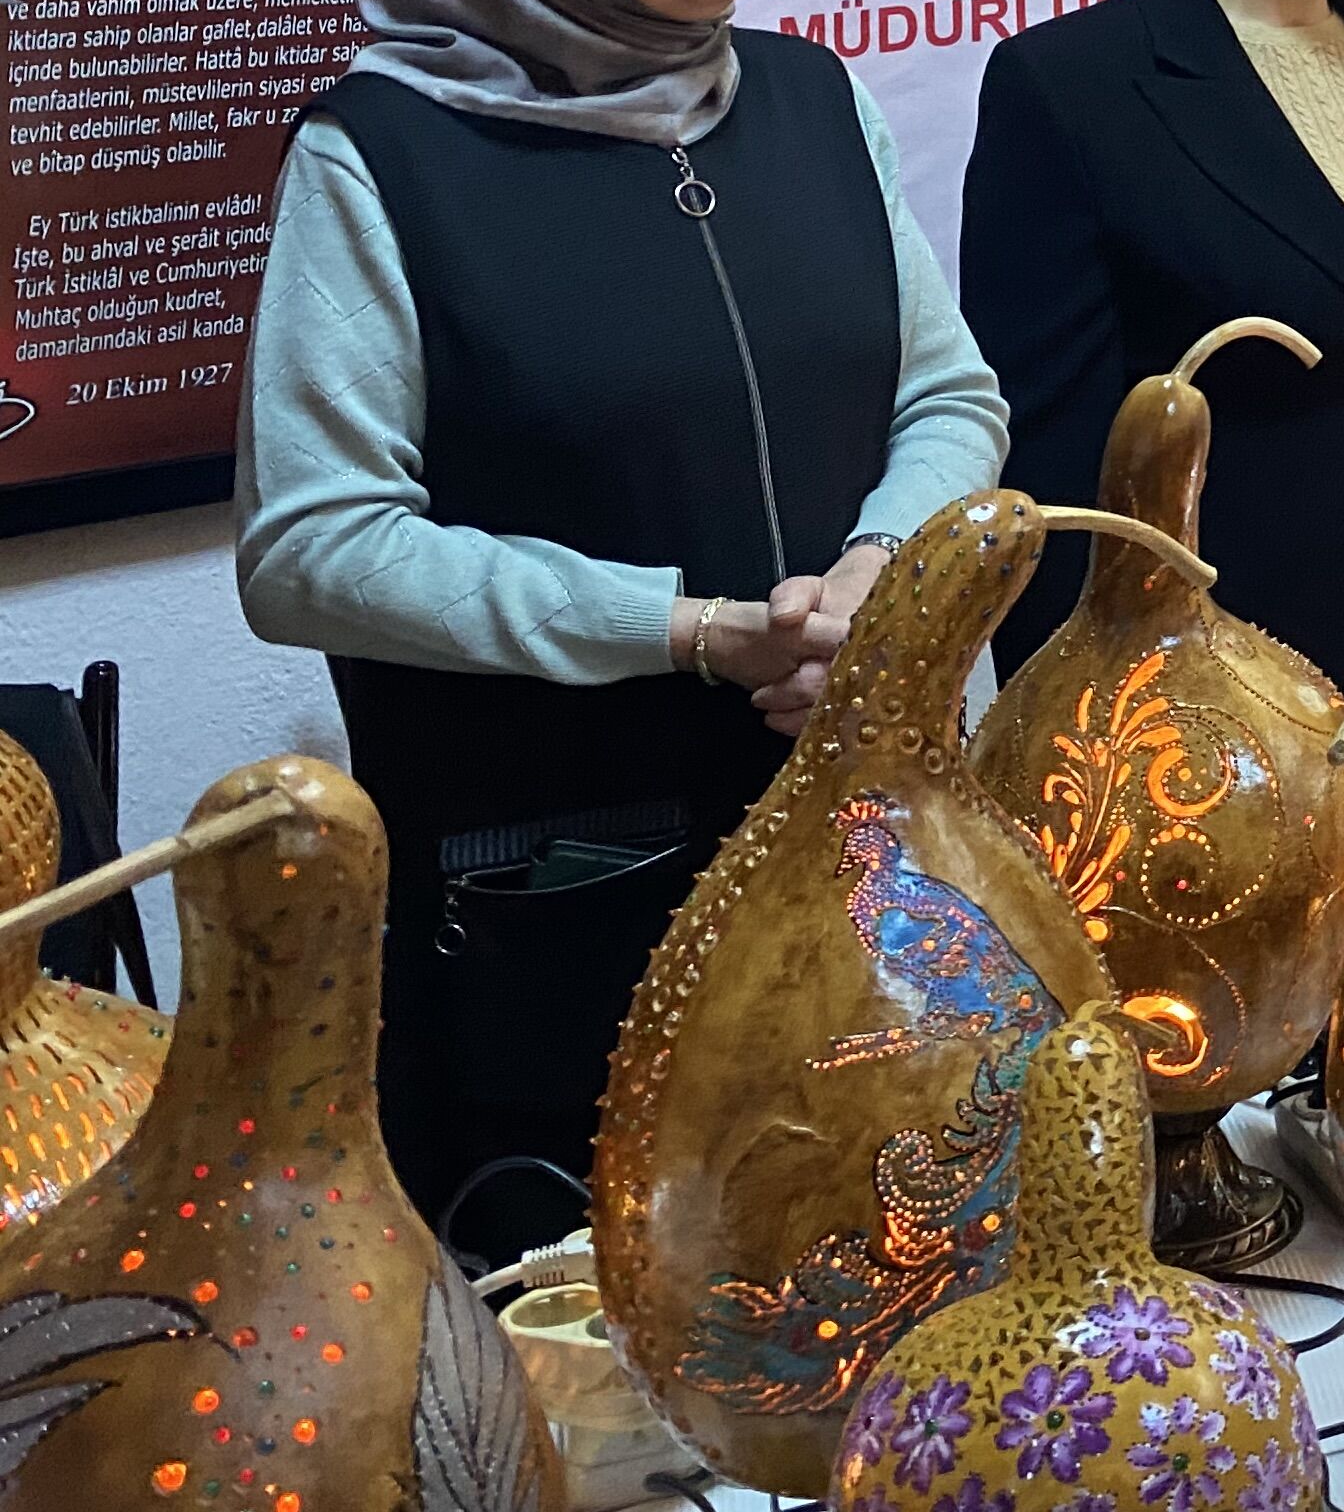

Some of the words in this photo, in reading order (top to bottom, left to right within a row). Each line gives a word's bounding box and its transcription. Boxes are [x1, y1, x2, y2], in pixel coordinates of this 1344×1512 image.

[7, 29, 77, 51] iktidara
[82, 25, 132, 50] sahip
[136, 21, 199, 44] olanlar
[202, 14, 314, 45] gaflet,dalâlet
[8, 59, 63, 87] içinde
[68, 52, 188, 79] bulunabilirler.
[195, 46, 242, 71] Hattâ
[247, 47, 269, 67] bu
[274, 44, 329, 65] iktidar
[8, 85, 135, 113] menfaatlerini,
[142, 78, 254, 104] müstevlilerin
[258, 73, 305, 99] siyasi
[10, 121, 65, 145] tevhit
[69, 114, 162, 140] edebilirler.
[168, 110, 219, 133] Millet,
[226, 107, 262, 127] fakr
[39, 150, 86, 175] bîtap
[90, 144, 161, 172] düşmüş
[166, 138, 227, 163] olabilir.
[28, 215, 52, 240] Ey
[58, 209, 100, 233] Türk
[105, 201, 200, 228] istikbalinin
[205, 194, 262, 218] evlâdı!
[12, 239, 55, 273] İşte,
[61, 243, 85, 264] bu
[90, 235, 140, 260] ahval
[144, 237, 166, 253] ve
[170, 227, 221, 256] şerâit
[15, 275, 57, 299] Türk
[62, 266, 123, 294] İstiklâl
[128, 269, 150, 286] ve
[15, 306, 82, 330] Muhtaç
[87, 294, 159, 322] olduğun
[164, 288, 226, 311] kudret,
[15, 325, 152, 362] damarlarındaki
[157, 319, 187, 343] asil
[192, 314, 245, 338] kanda
[65, 383, 98, 405] 20
[105, 374, 168, 399] Ekim
[179, 363, 233, 388] 1927
